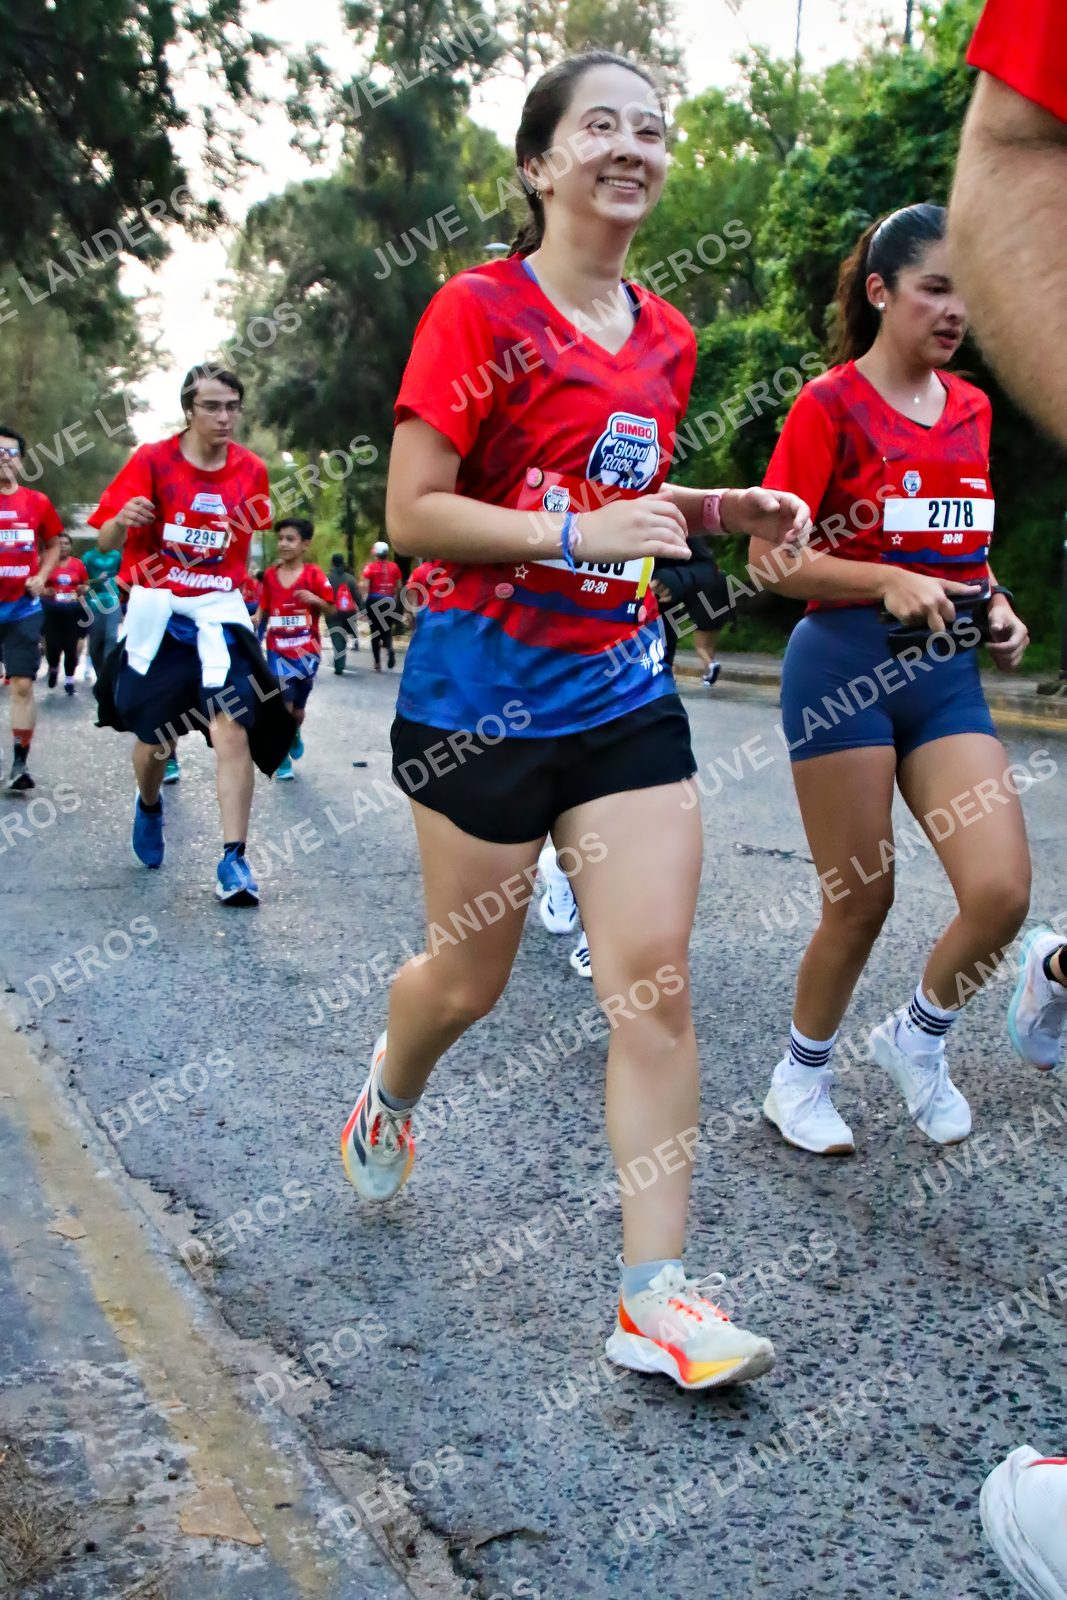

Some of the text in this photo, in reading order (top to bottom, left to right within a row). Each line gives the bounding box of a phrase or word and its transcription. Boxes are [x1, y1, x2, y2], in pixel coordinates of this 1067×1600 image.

[615, 421, 652, 440] BIMBO
[613, 440, 650, 462] Global
[601, 453, 633, 473] Race
[928, 500, 974, 528] 2778
